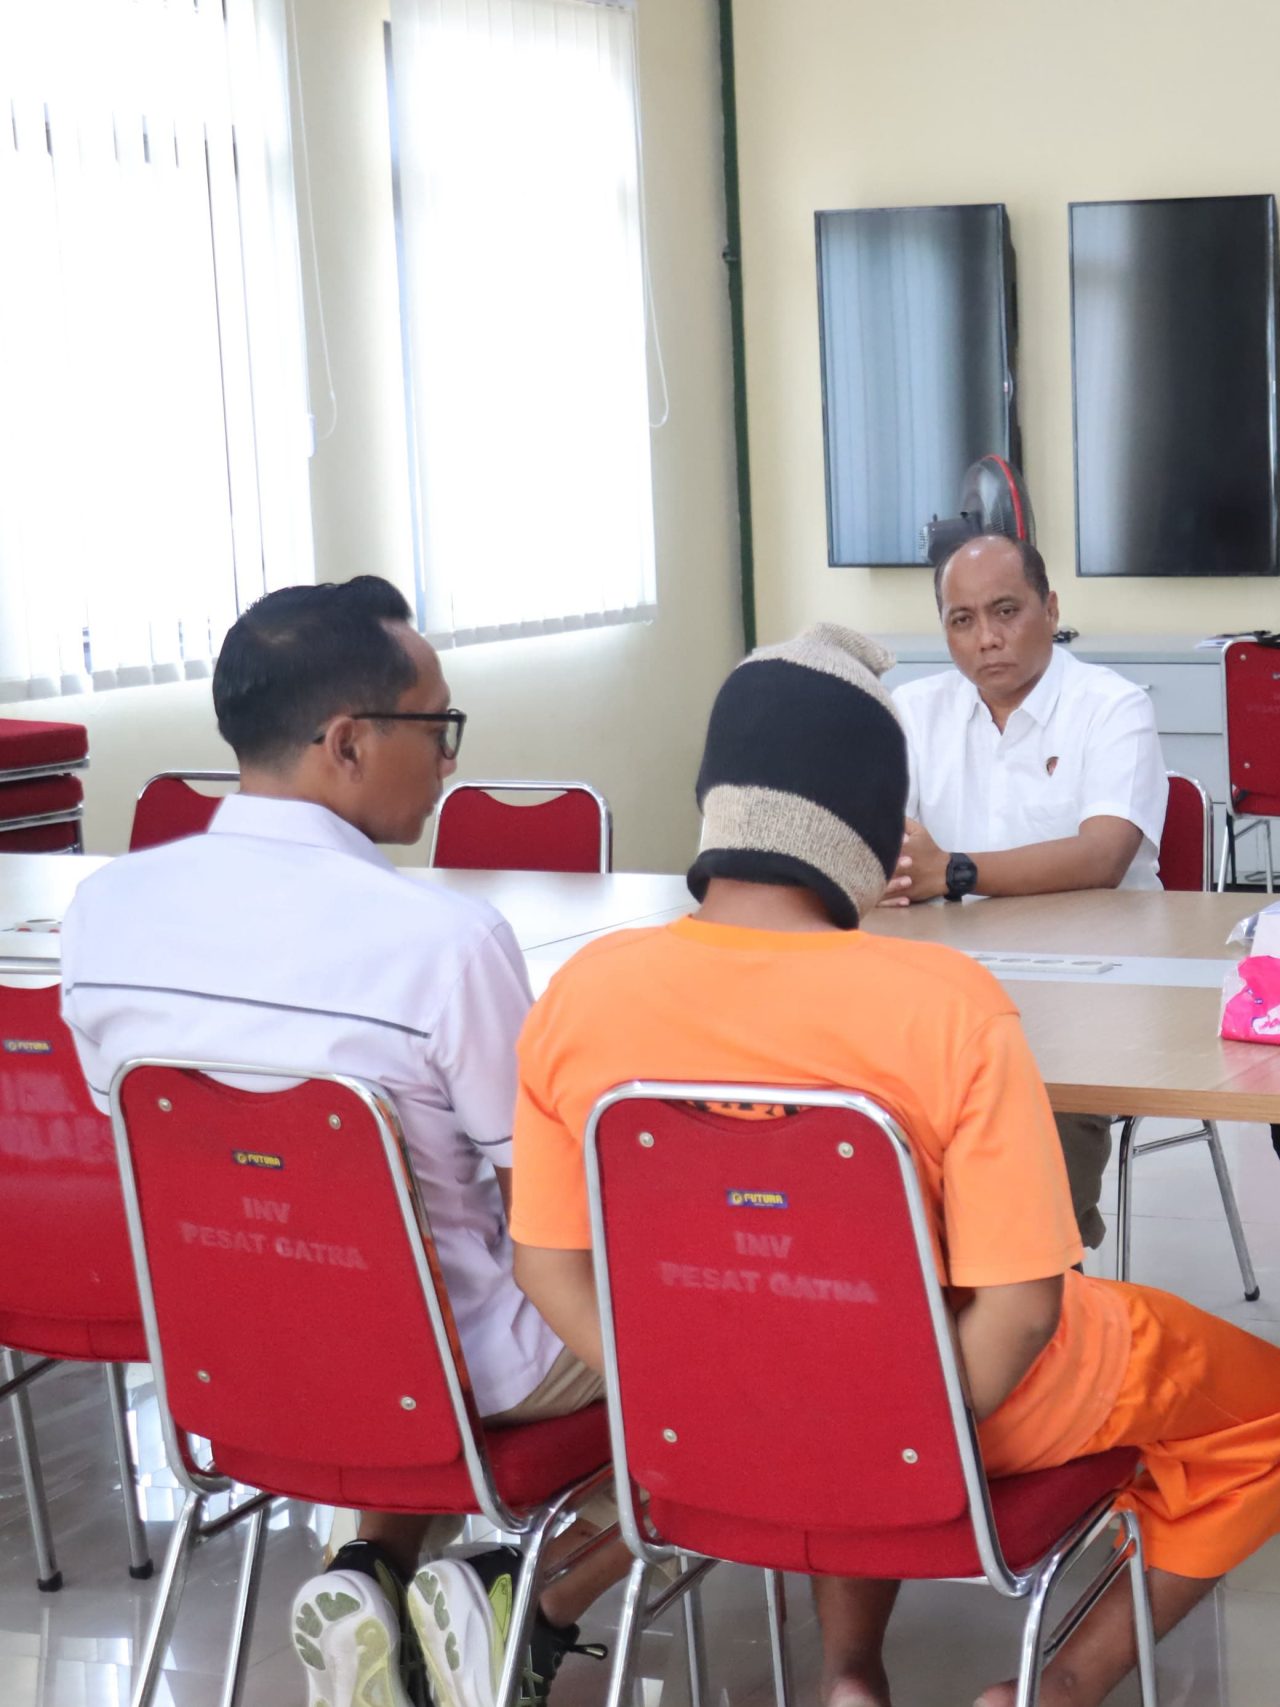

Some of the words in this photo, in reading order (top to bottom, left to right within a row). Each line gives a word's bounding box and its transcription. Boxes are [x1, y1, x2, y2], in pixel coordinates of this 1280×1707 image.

[241, 1196, 291, 1224] INV
[743, 1192, 784, 1204] FUTURA
[179, 1221, 266, 1255] PESAT
[275, 1236, 368, 1270] GATRA
[733, 1230, 793, 1259] INV
[658, 1260, 761, 1294] PESAT
